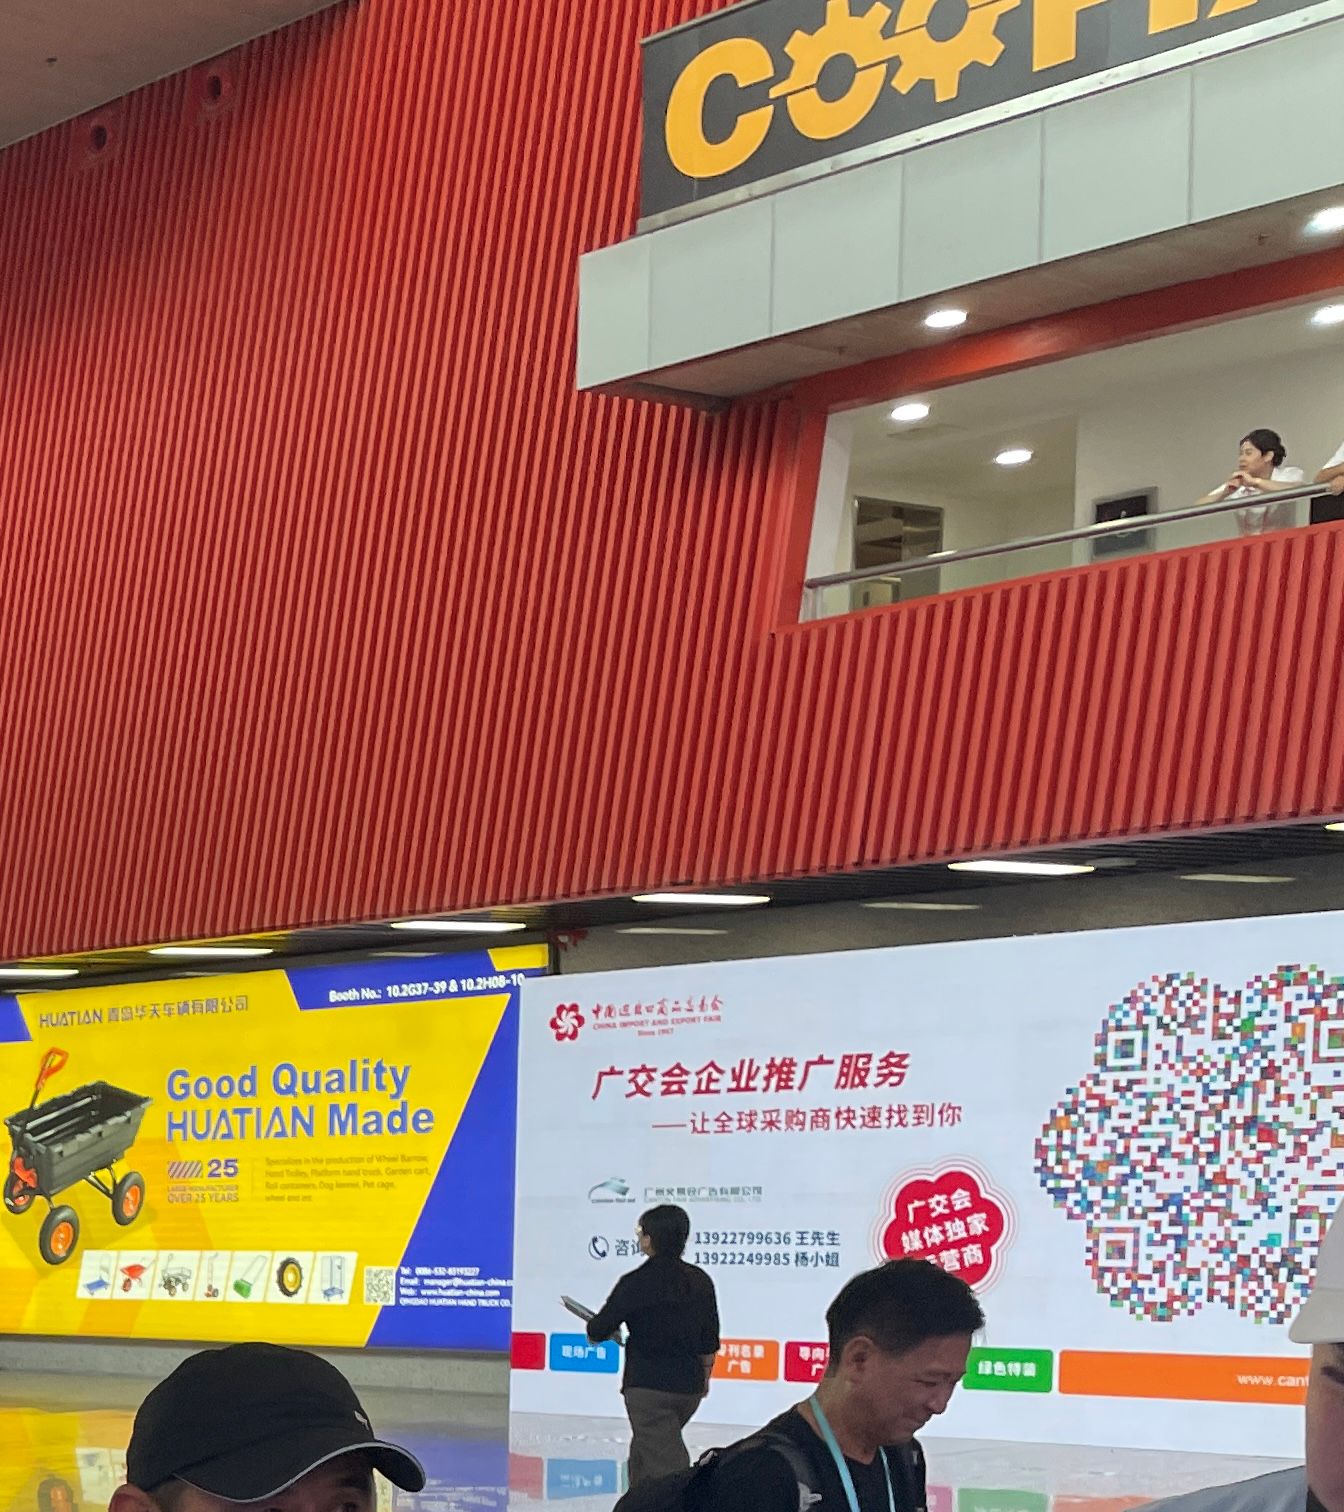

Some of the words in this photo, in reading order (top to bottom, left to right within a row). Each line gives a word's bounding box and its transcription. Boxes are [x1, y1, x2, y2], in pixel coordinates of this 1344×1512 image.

[329, 986, 357, 1003] Booth
[358, 984, 381, 1001] No.:
[448, 979, 459, 993] &
[39, 1008, 103, 1028] HUATIAN
[167, 1063, 258, 1103] Good
[272, 1058, 411, 1100] Quality
[592, 1050, 911, 1101] 广交会企业推广服务
[166, 1103, 316, 1144] HUATIAN
[327, 1101, 435, 1137] Made
[207, 1158, 239, 1179] 25
[907, 1188, 974, 1224] 广交会
[694, 1231, 792, 1247] 13922799636
[794, 1231, 841, 1247] 王先生
[900, 1211, 991, 1255] 媒体独家
[694, 1252, 791, 1267] 13922249985
[794, 1252, 840, 1268] 杨小姐
